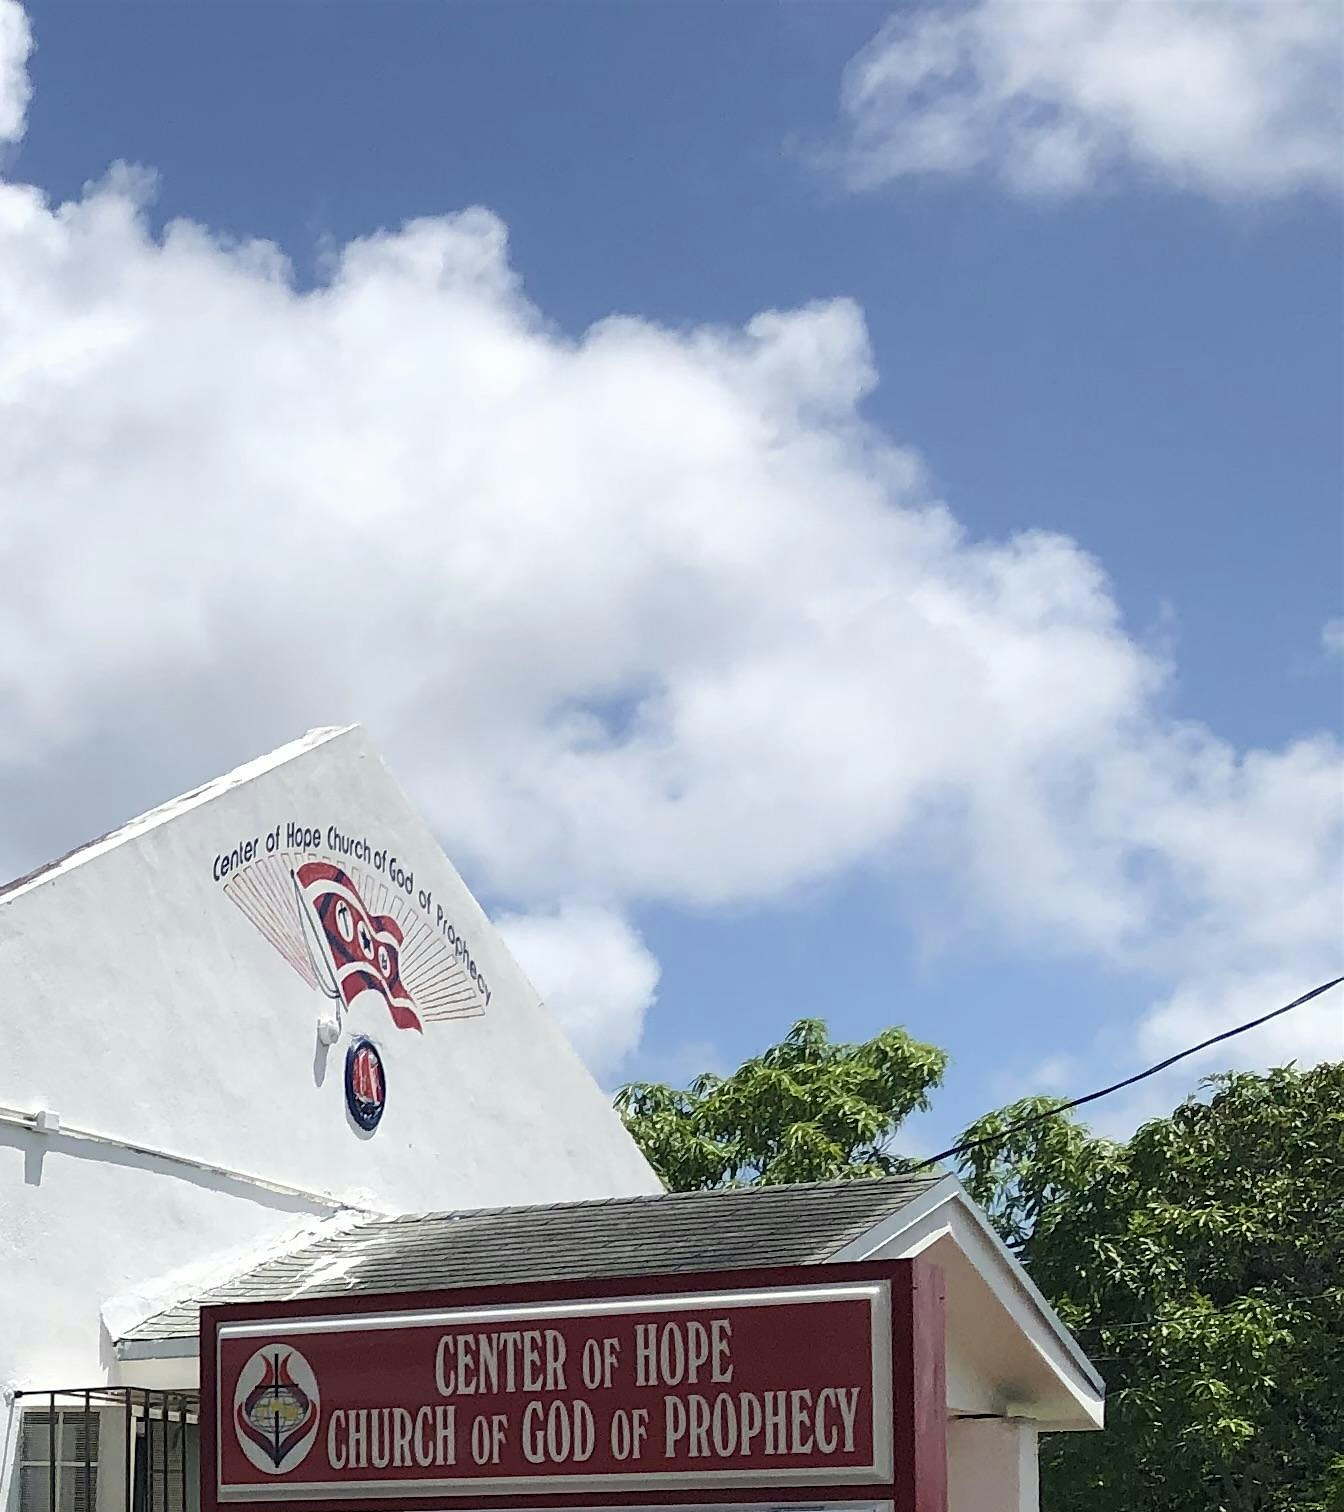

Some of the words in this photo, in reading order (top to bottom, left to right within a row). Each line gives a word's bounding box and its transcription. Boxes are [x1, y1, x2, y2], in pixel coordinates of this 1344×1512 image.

[213, 838, 259, 882] Center
[266, 825, 280, 852] of
[287, 822, 321, 853] Hope
[327, 825, 371, 864] Church
[374, 851, 386, 872] of
[390, 857, 414, 895] God
[419, 889, 432, 914] of
[437, 904, 492, 1006] Prophecy
[434, 1329, 567, 1396] CENTER
[583, 1336, 621, 1389] OF
[634, 1318, 733, 1386] HOPE
[326, 1404, 456, 1470] CHURCH
[471, 1413, 509, 1465] OF
[521, 1399, 595, 1465] GOD
[611, 1408, 649, 1460] OF
[664, 1386, 861, 1459] PROPHECY
